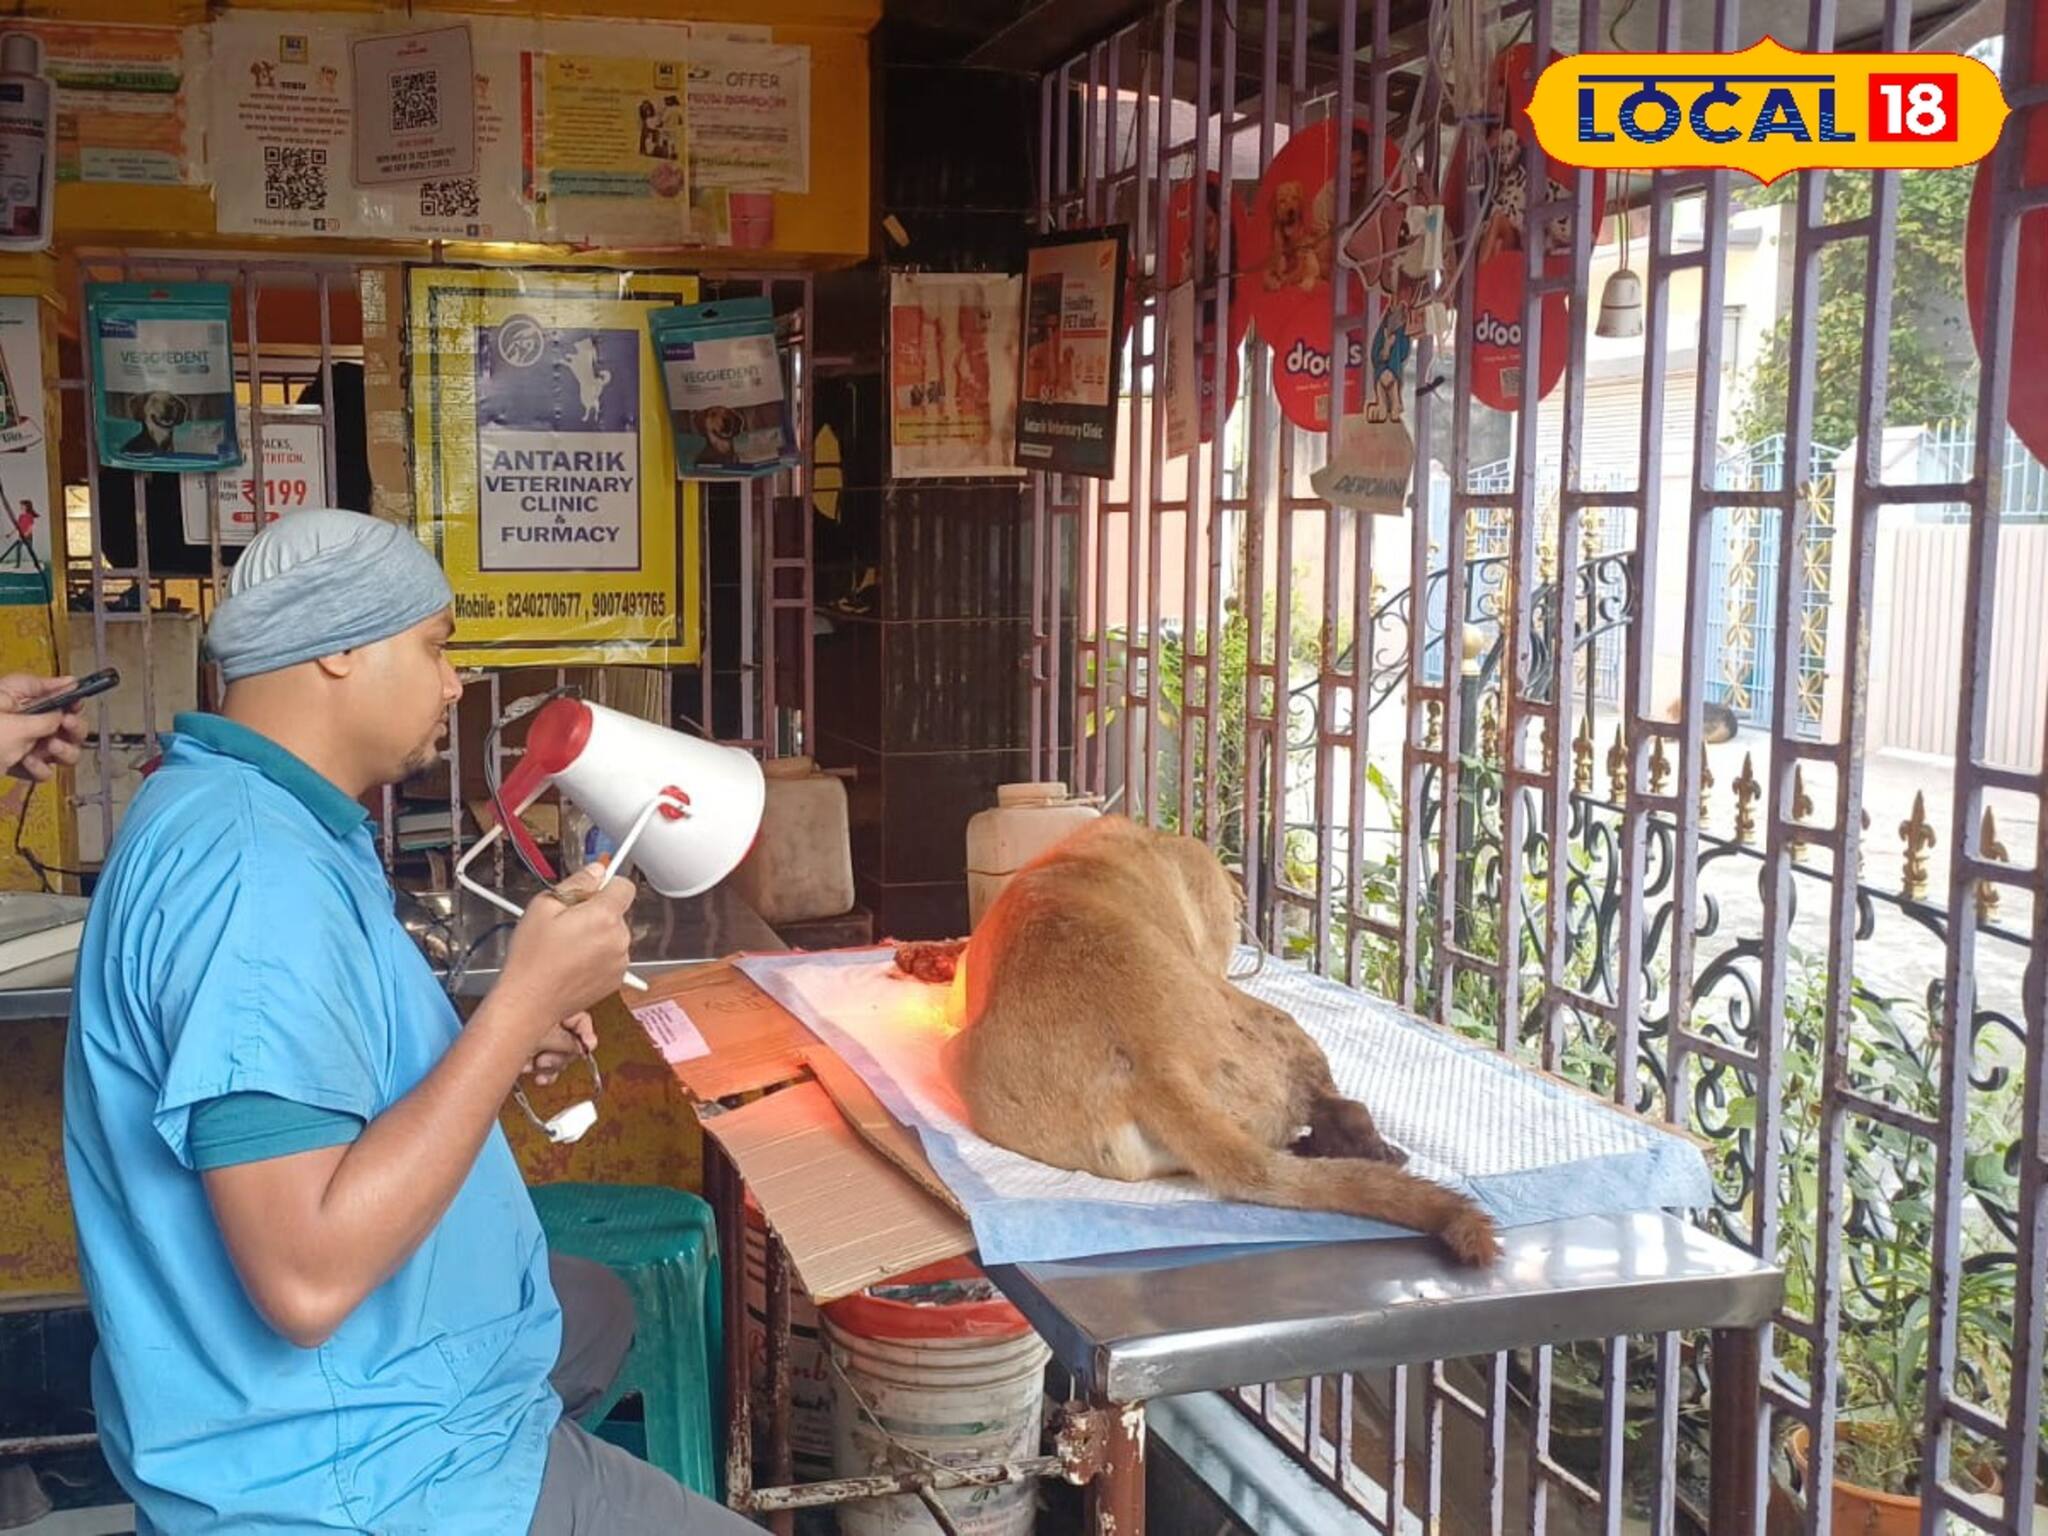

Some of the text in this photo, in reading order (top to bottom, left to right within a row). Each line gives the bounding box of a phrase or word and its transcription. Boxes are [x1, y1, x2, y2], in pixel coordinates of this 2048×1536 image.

[727, 72, 780, 89] OFFER
[1476, 312, 1522, 347] droo
[493, 450, 626, 472] ANTARIK
[486, 476, 634, 493] VETERINARY
[521, 496, 599, 512] CLINIC
[555, 514, 566, 524] &
[501, 527, 620, 543] FURMACY
[455, 593, 496, 618] Mobile
[507, 592, 581, 618] 8240270677
[592, 592, 666, 618] 9007493765
